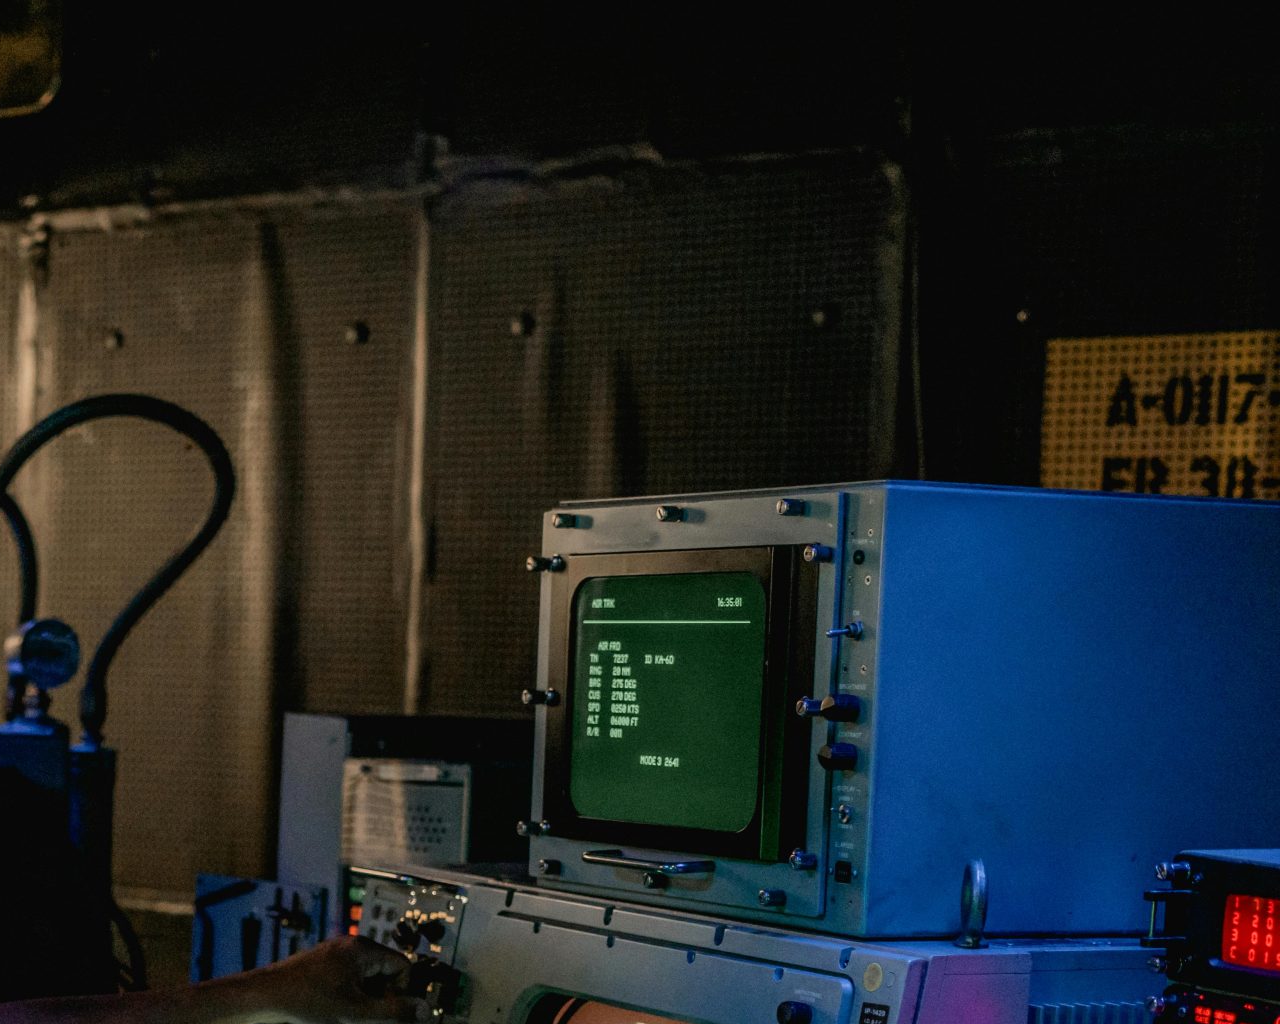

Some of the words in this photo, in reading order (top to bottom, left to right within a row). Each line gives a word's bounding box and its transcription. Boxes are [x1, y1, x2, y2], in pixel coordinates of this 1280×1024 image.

[624, 679, 637, 689] DEG
[624, 691, 637, 701] DEG
[630, 716, 639, 726] FT
[1233, 912, 1240, 925] 2
[1231, 928, 1239, 941] 3
